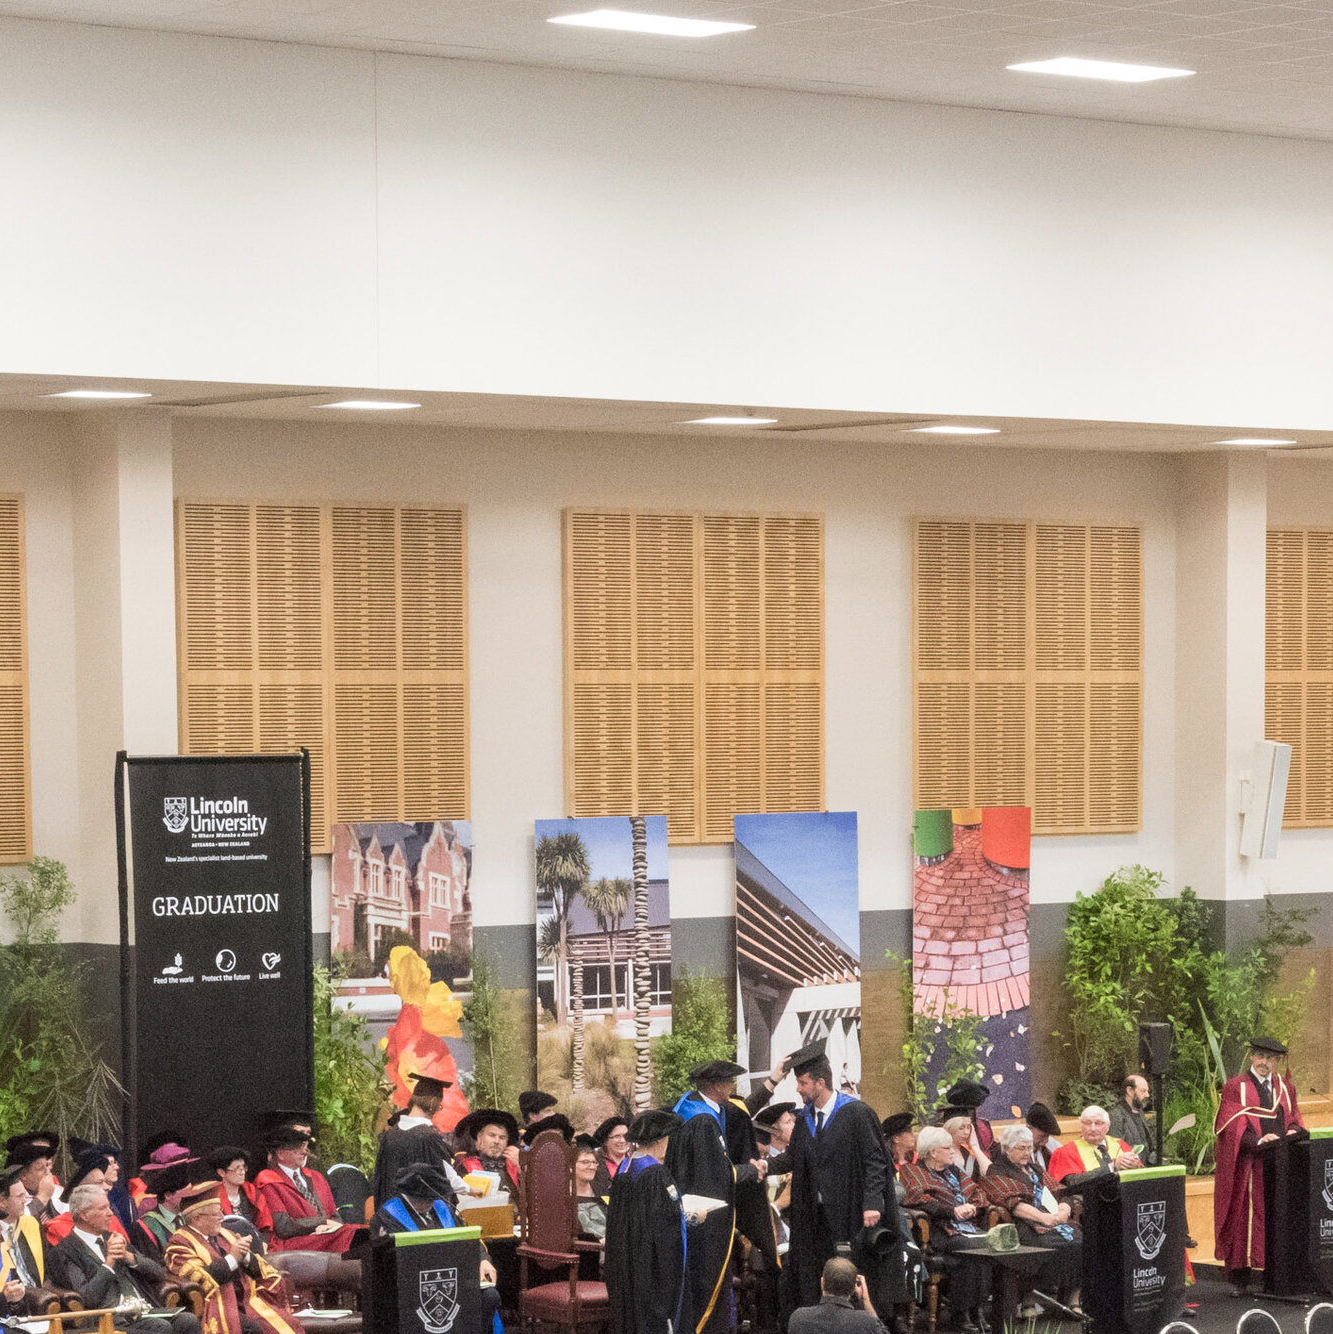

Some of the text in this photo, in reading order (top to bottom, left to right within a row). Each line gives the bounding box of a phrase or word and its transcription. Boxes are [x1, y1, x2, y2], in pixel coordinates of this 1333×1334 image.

[190, 796, 248, 814] Lincoln
[190, 814, 267, 835] University
[152, 893, 279, 916] GRADUATION
[201, 974, 222, 982] Protect
[234, 973, 250, 981] future
[259, 972, 269, 980] Live
